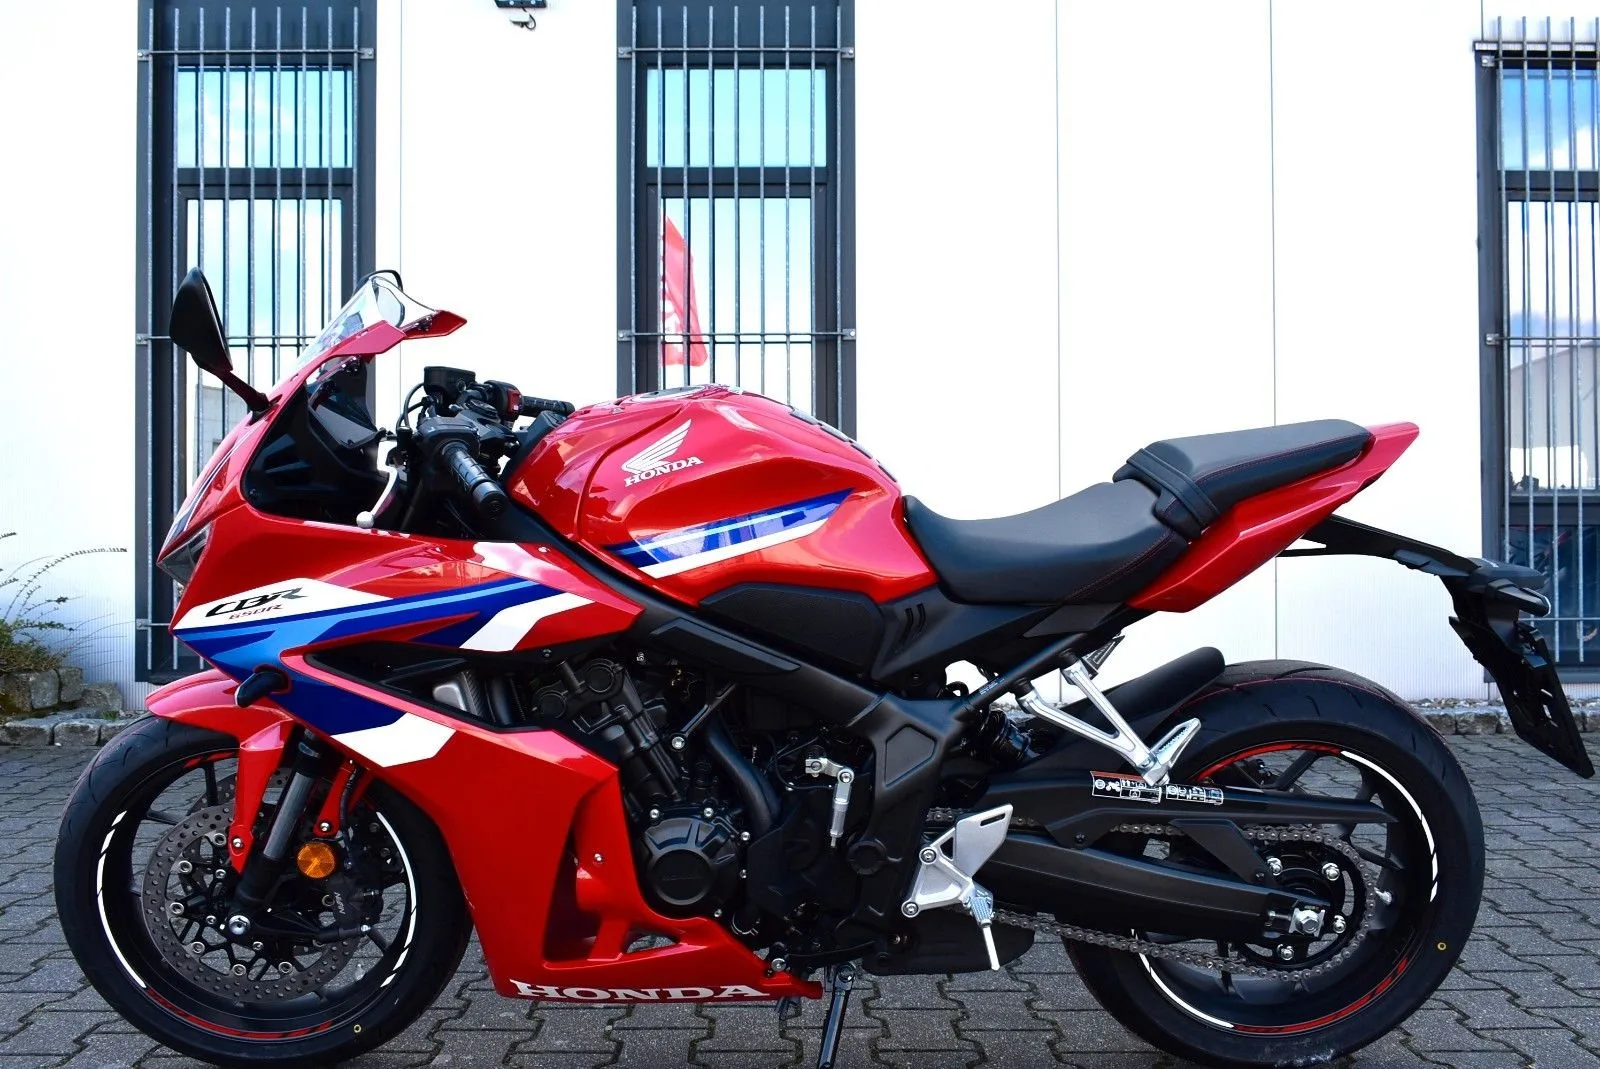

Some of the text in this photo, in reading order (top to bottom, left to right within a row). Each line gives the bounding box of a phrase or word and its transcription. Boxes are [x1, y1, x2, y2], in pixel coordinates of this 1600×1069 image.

[624, 456, 704, 487] HONDA
[205, 587, 308, 617] CBR
[229, 604, 283, 619] 650R
[509, 979, 771, 1000] HONDA
